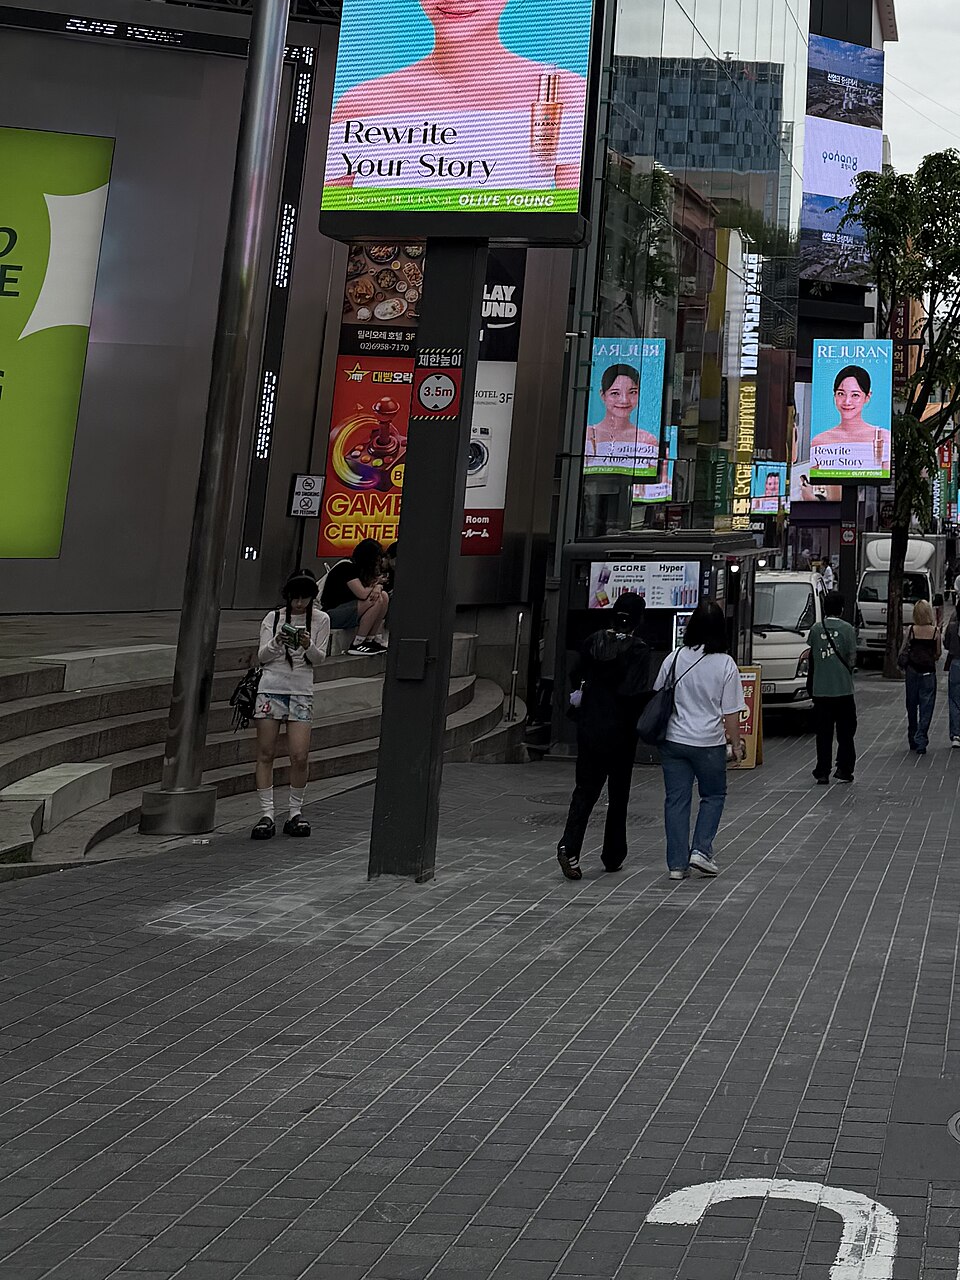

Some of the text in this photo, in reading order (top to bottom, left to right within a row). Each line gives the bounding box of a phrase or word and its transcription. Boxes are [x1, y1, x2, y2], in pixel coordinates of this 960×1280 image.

[343, 120, 458, 146] Rewrite
[342, 153, 497, 184] Your Story
[458, 194, 500, 206] OLIVE
[506, 195, 555, 206] YOUNG
[483, 285, 516, 301] LAY
[481, 301, 517, 318] UND
[358, 330, 386, 340] 밀리오레
[405, 333, 416, 341] 3F
[817, 346, 888, 358] REJURAN
[418, 354, 461, 367] 제한높이
[423, 386, 453, 397] 3.5m
[499, 393, 513, 403] 3F
[815, 447, 850, 455] Rewrite
[814, 458, 864, 468] Your Story
[465, 515, 490, 524] Room
[659, 564, 684, 572] Hyper
